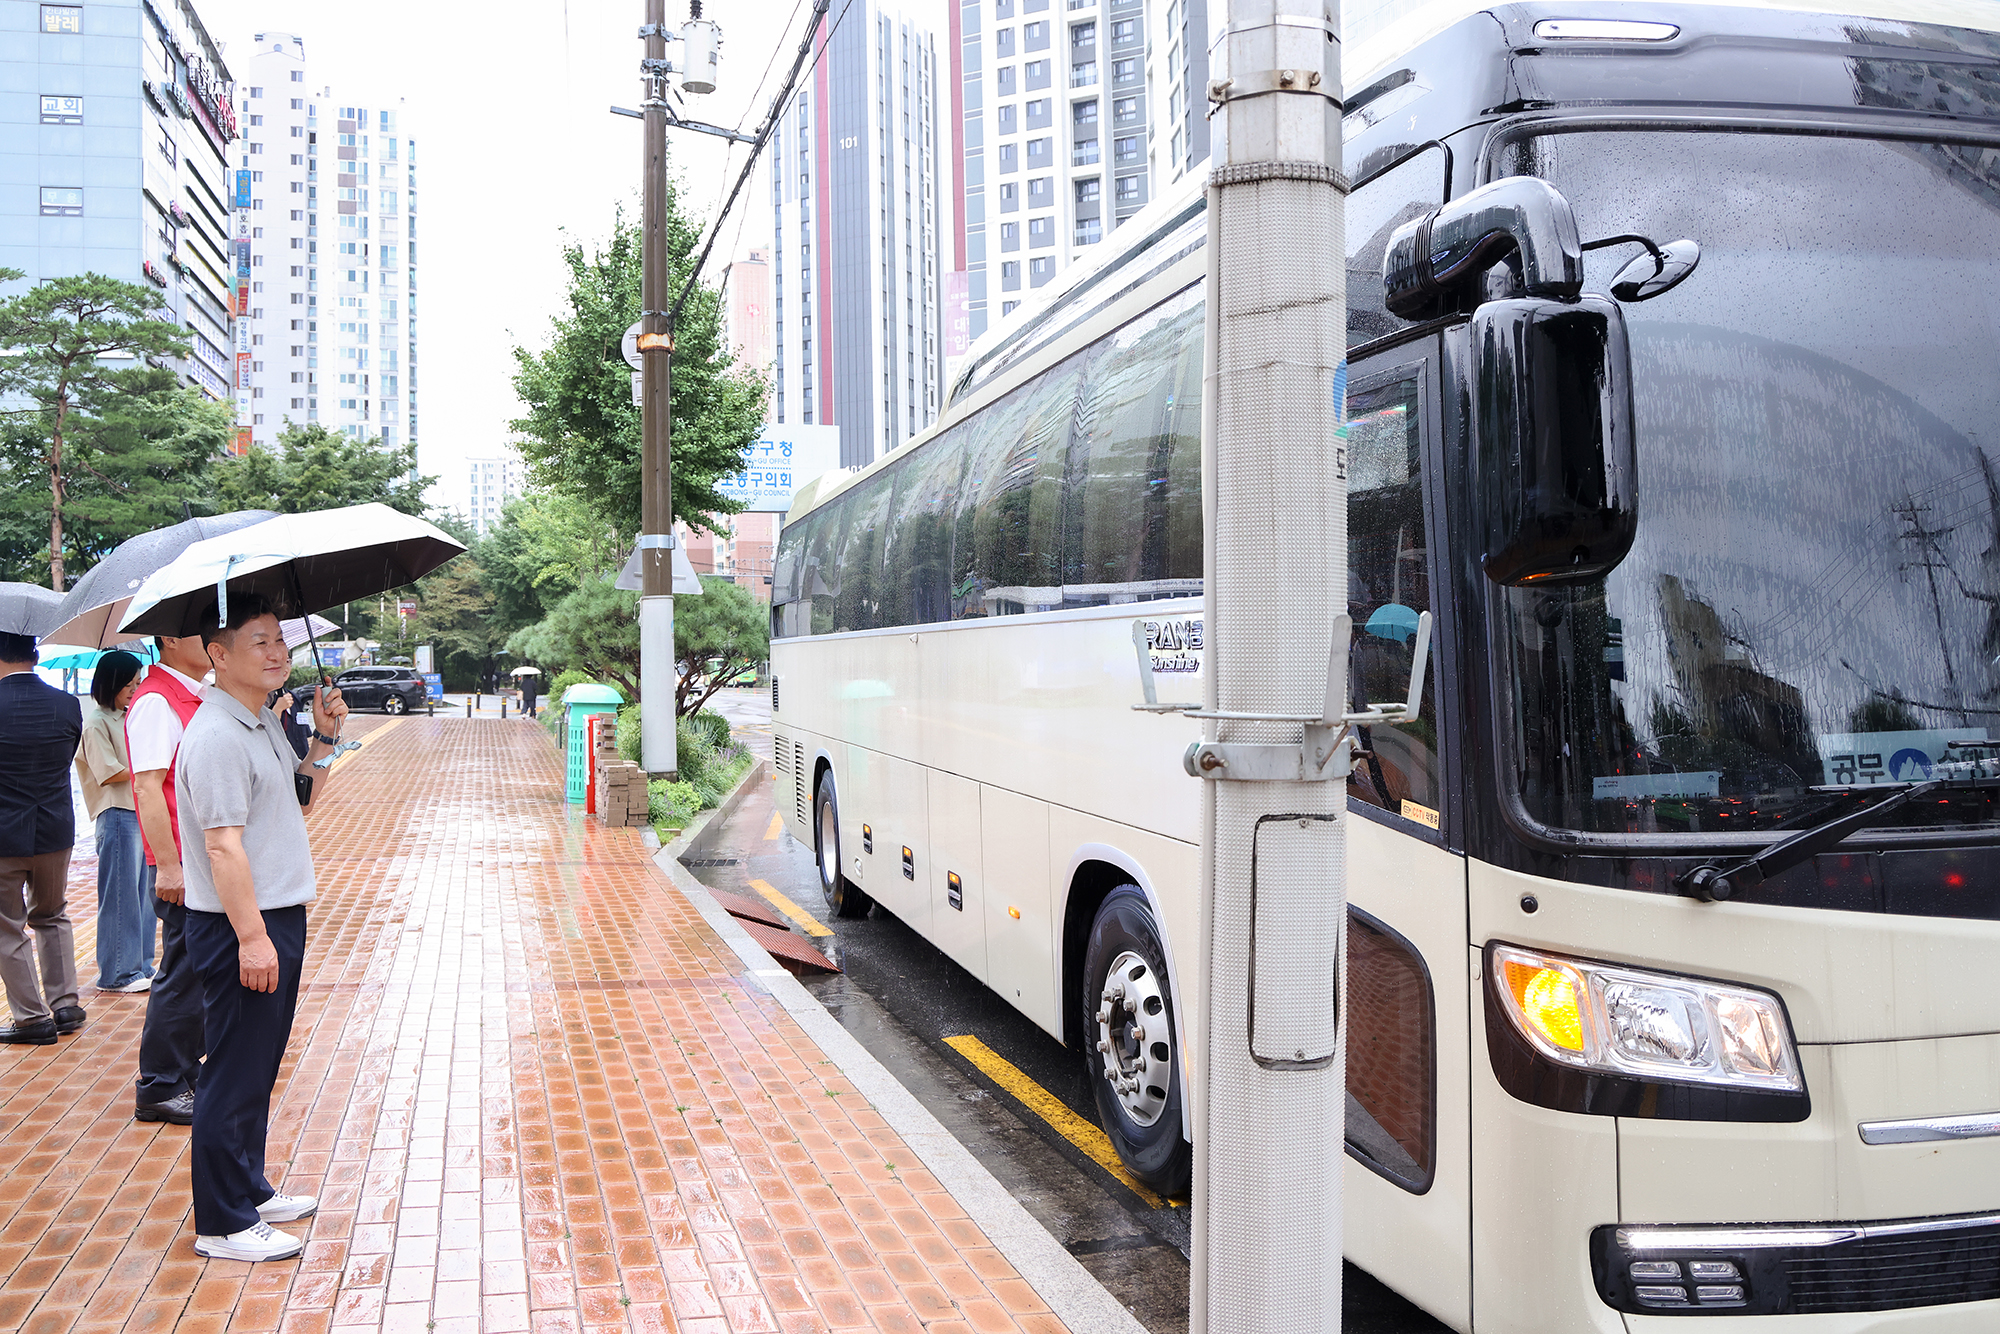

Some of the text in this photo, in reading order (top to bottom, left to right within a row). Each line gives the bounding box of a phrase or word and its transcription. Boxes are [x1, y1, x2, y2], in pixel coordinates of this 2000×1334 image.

[45, 15, 79, 33] 발레
[43, 98, 80, 114] 교회
[839, 135, 858, 150] 101
[769, 457, 791, 466] OFFICE
[763, 489, 791, 498] COUNCIL
[1831, 753, 1887, 786] 공무
